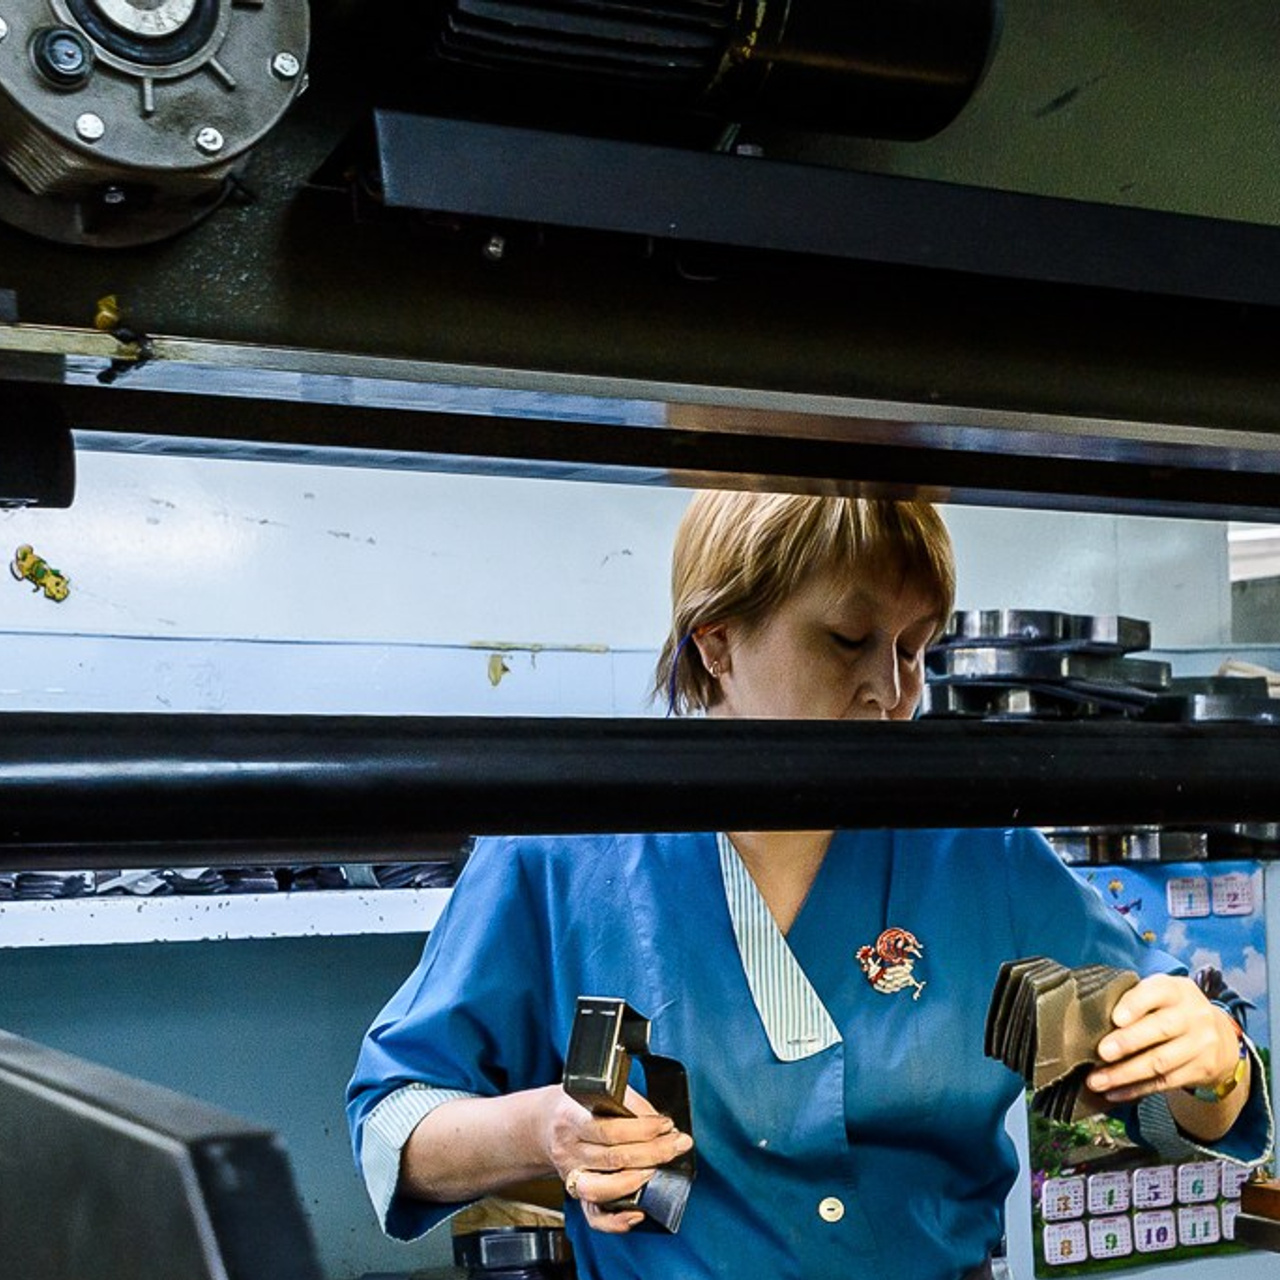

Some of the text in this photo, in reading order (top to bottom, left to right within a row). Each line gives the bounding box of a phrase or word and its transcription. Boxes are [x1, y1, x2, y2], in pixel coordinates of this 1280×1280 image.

[1227, 893, 1240, 909] 2
[1057, 1195, 1072, 1212] 3
[1147, 1184, 1160, 1201] 5
[1192, 1179, 1204, 1195] 6
[1060, 1239, 1073, 1256] 8
[1104, 1232, 1118, 1250] 9
[1145, 1226, 1168, 1245] 10
[1191, 1221, 1210, 1239] 11
